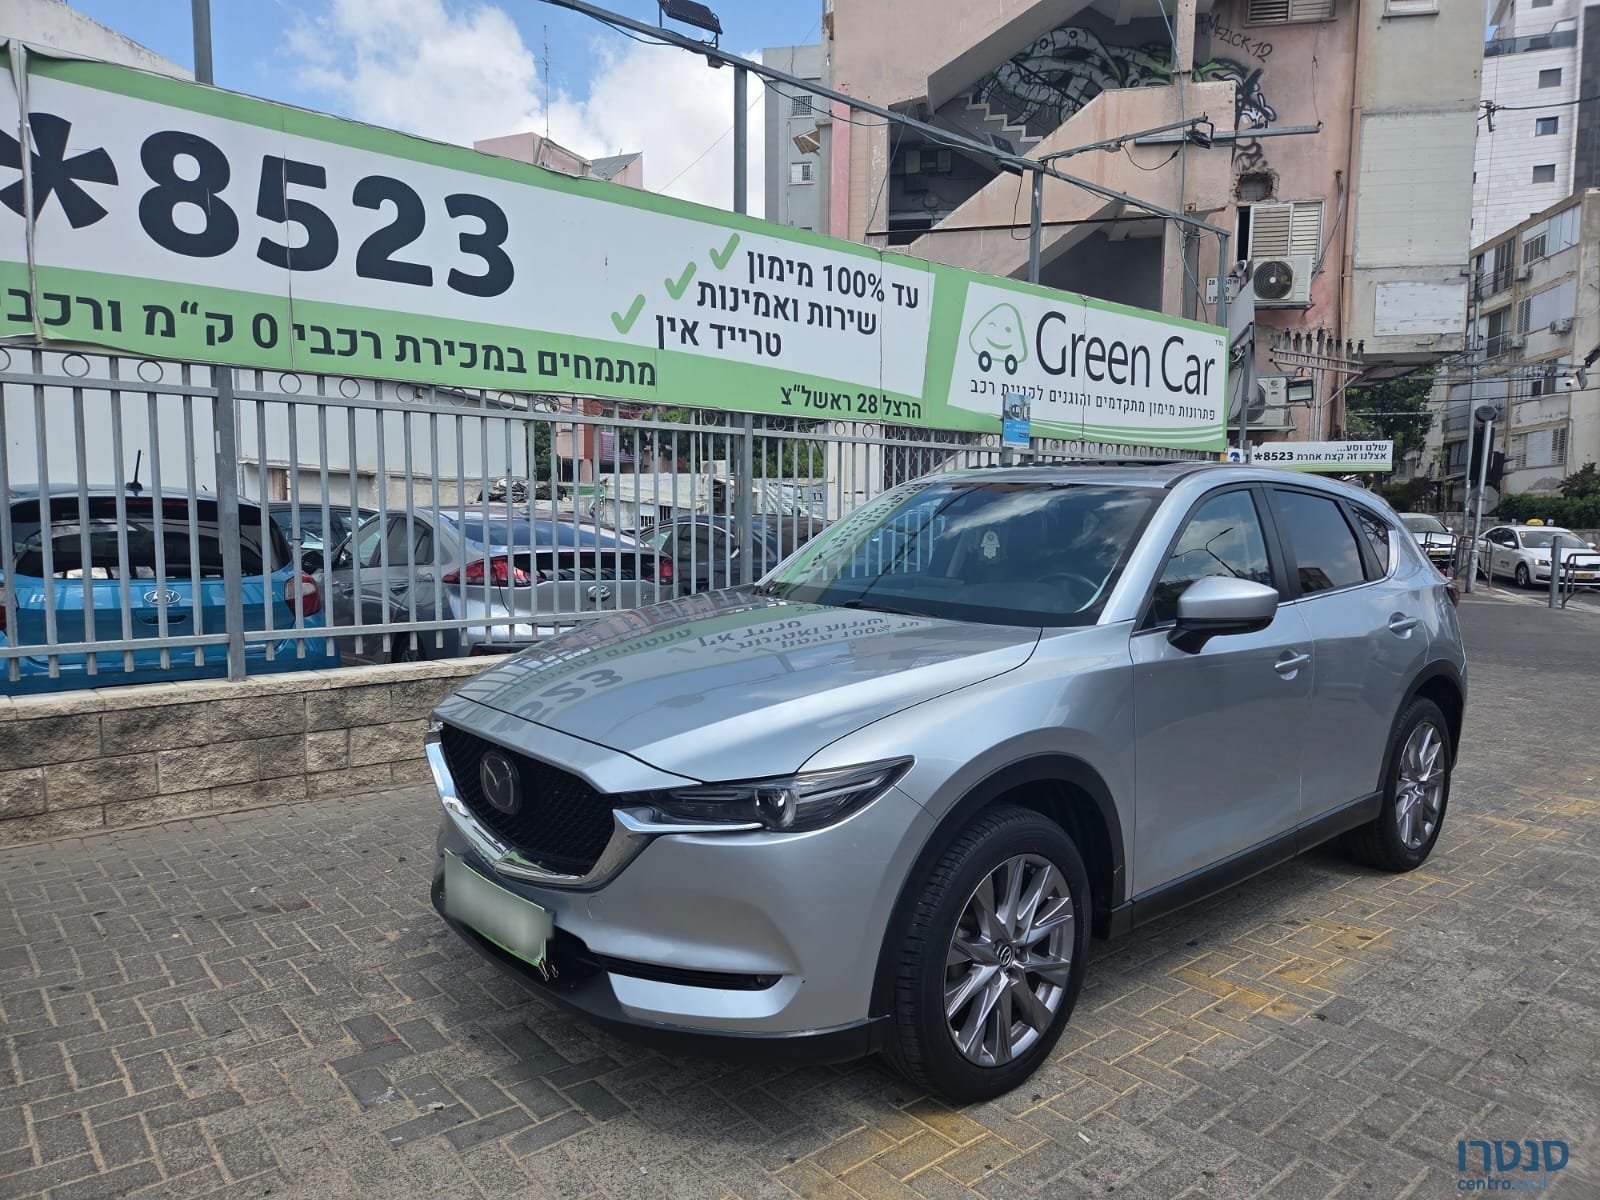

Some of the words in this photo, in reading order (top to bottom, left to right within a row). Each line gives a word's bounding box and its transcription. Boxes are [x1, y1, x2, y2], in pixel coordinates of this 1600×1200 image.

[747, 250, 814, 288] מימון
[823, 264, 885, 302] 100%
[697, 280, 799, 323] ואמינות
[891, 281, 919, 309] עד
[0, 287, 122, 333] ורכב
[806, 301, 877, 336] שירות
[293, 322, 382, 361] רכבי
[656, 314, 700, 350] אין
[709, 322, 782, 357] טרייד
[395, 332, 527, 375] במכירת
[1035, 310, 1151, 389] Green
[1160, 335, 1215, 397] Car
[538, 350, 657, 388] מתמחים
[970, 379, 995, 396] רכב
[1050, 389, 1091, 407] והוגנים
[857, 392, 878, 415] 28
[882, 394, 922, 420] הרצל
[1096, 395, 1145, 413] מתקדמים
[1149, 401, 1176, 417] מימון
[1178, 405, 1216, 421] פתרונות
[1297, 453, 1322, 461] אחרת
[1324, 453, 1344, 462] קצת
[1360, 451, 1387, 460] אצלנו
[1366, 443, 1387, 452] שלם
